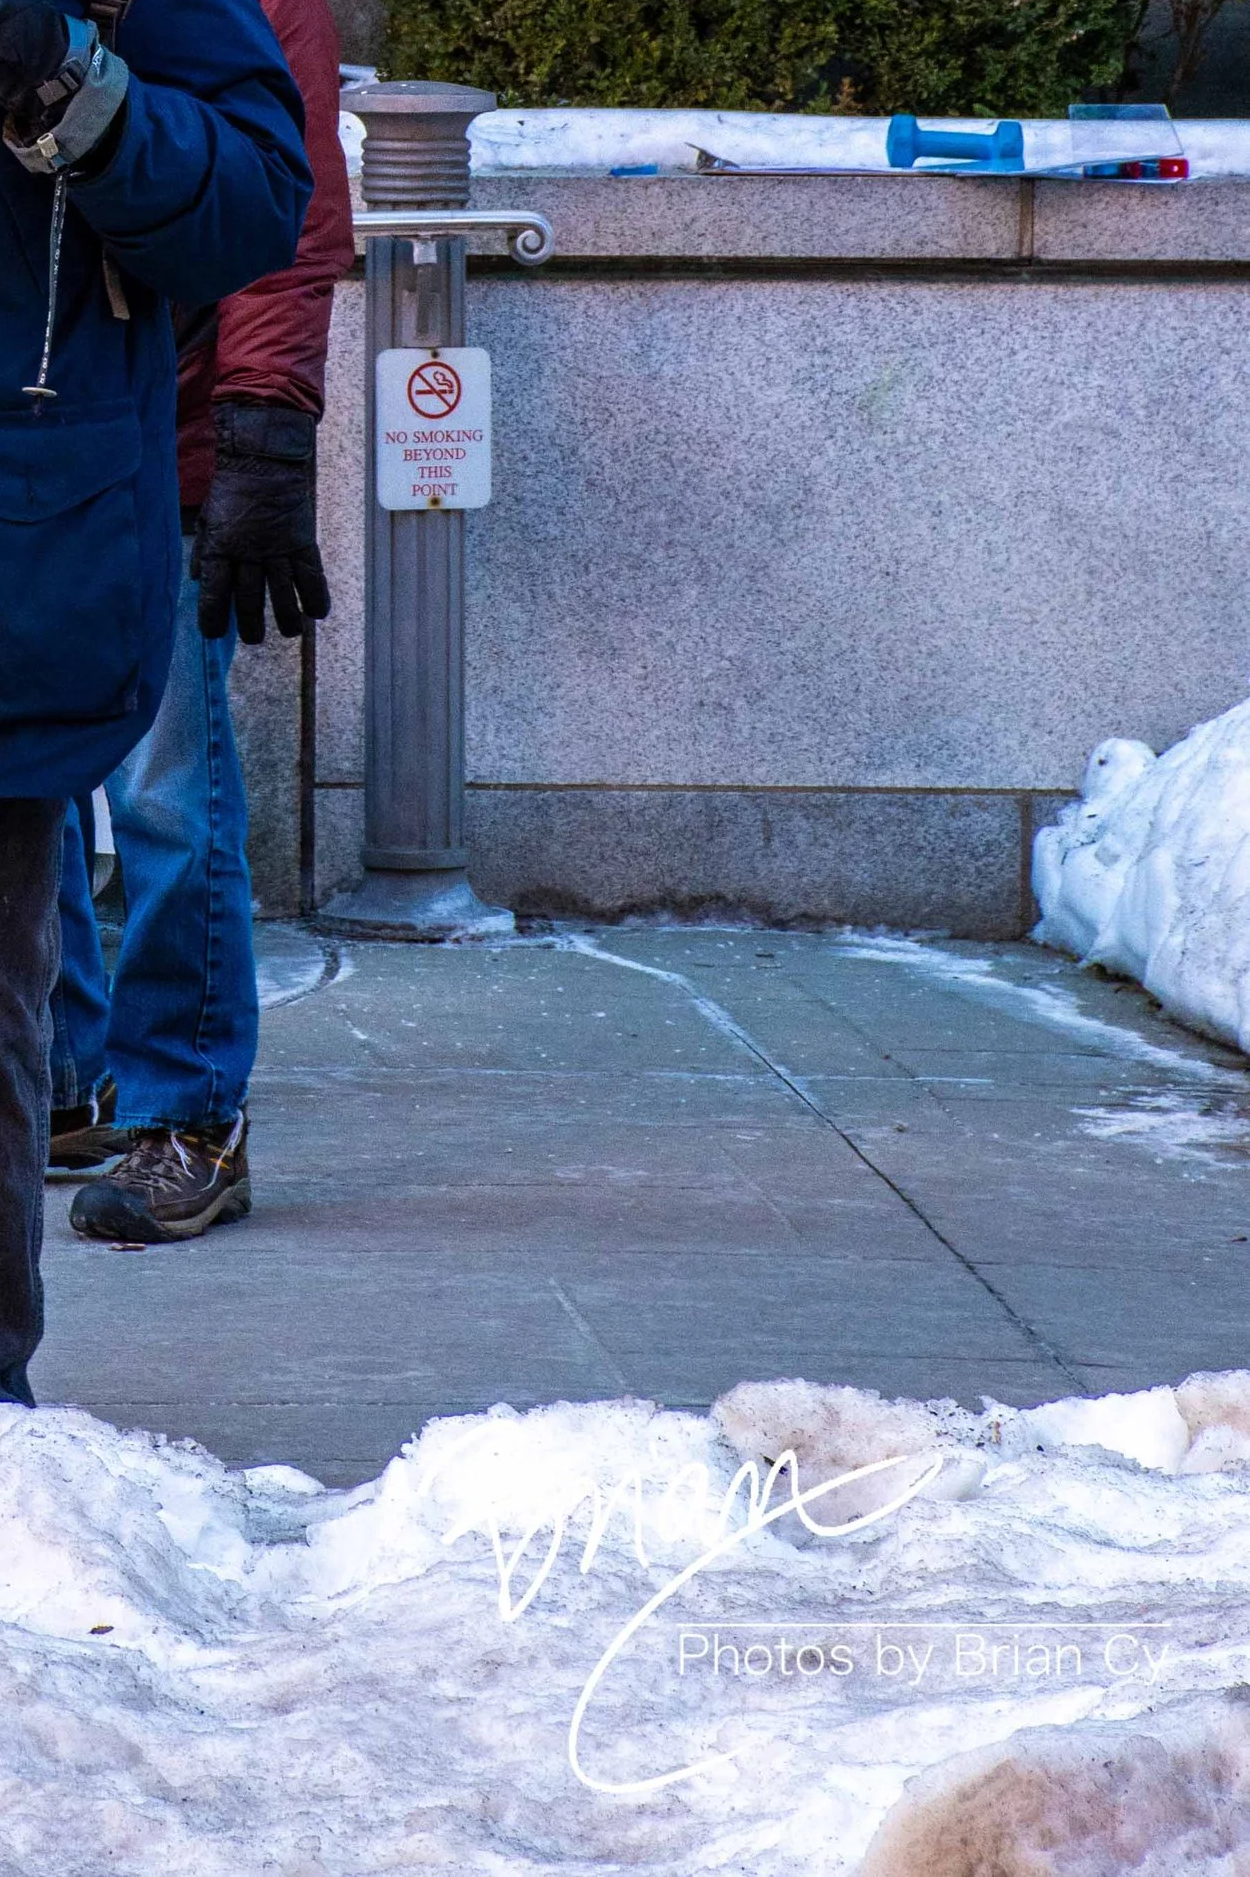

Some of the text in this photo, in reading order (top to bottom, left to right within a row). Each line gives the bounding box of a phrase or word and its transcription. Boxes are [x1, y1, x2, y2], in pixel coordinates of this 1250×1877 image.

[384, 429, 484, 445] NO SMOKING
[403, 447, 467, 462] BEYOND
[417, 465, 453, 479] THIS
[412, 483, 458, 497] POINT
